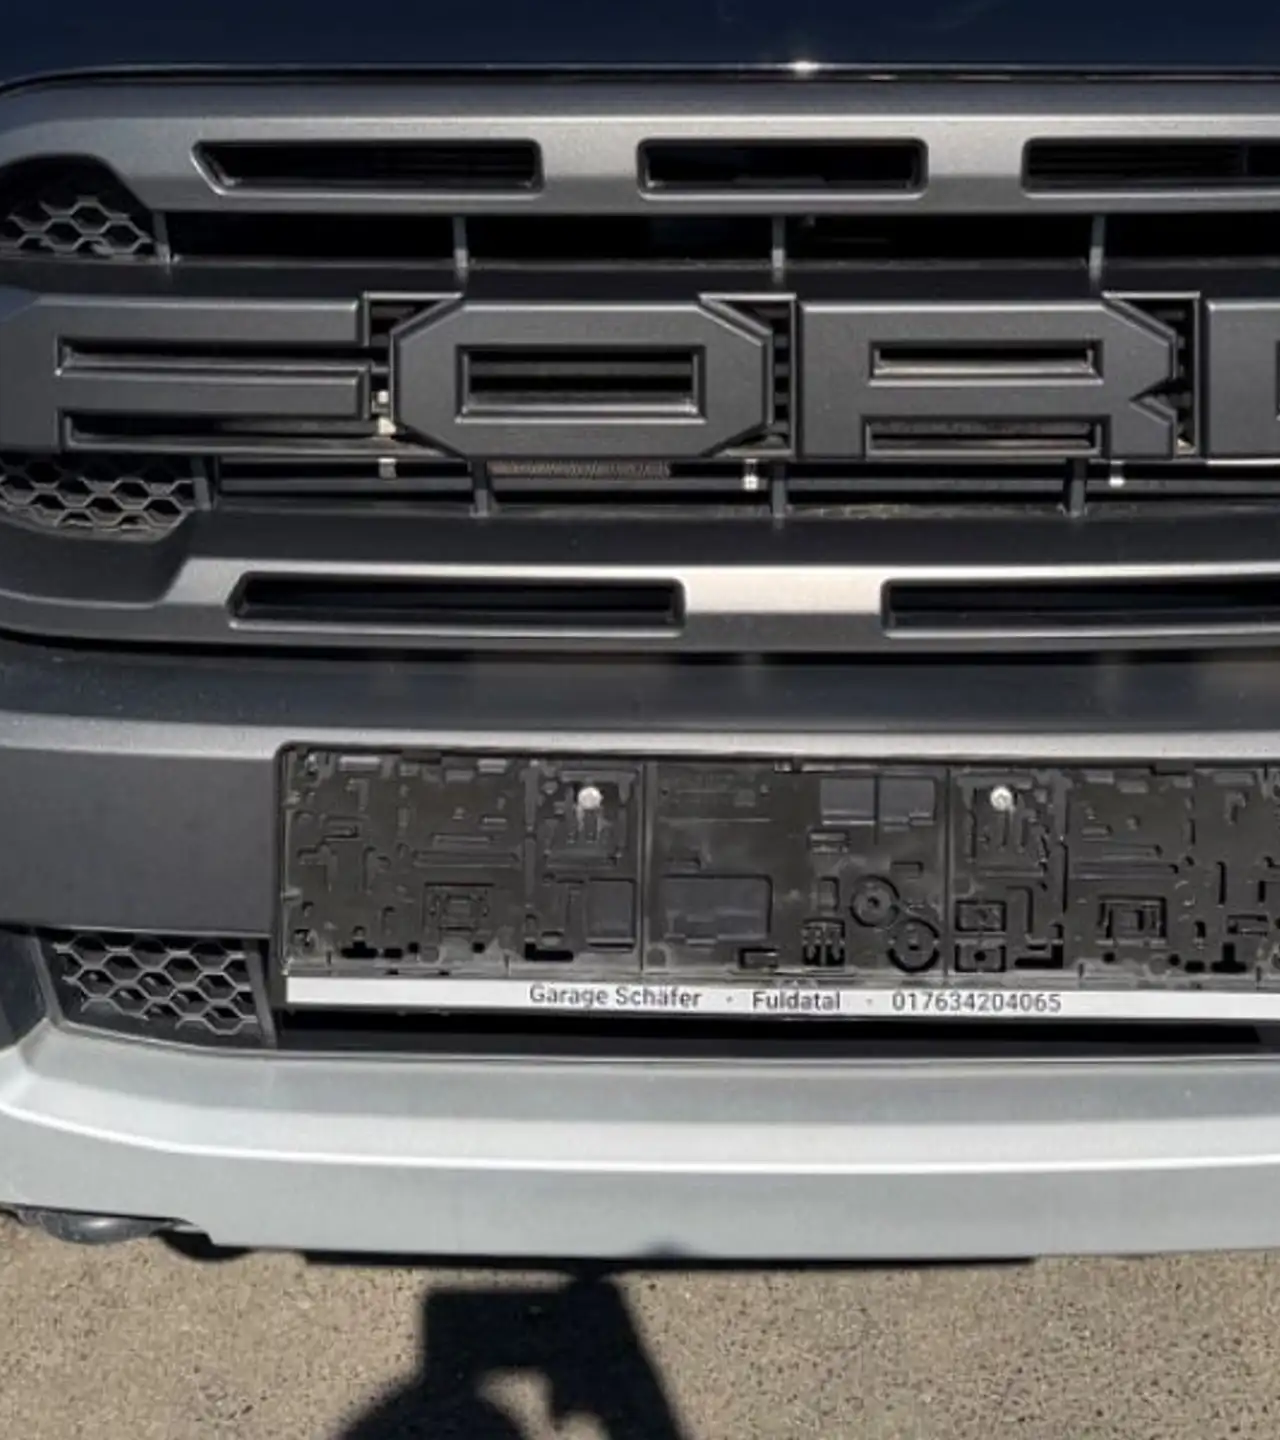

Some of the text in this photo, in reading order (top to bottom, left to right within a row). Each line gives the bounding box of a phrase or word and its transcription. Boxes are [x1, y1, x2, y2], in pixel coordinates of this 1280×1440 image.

[528, 985, 609, 1008] Garage
[751, 991, 842, 1011] Fuldatal
[891, 992, 1062, 1012] 017634204065
